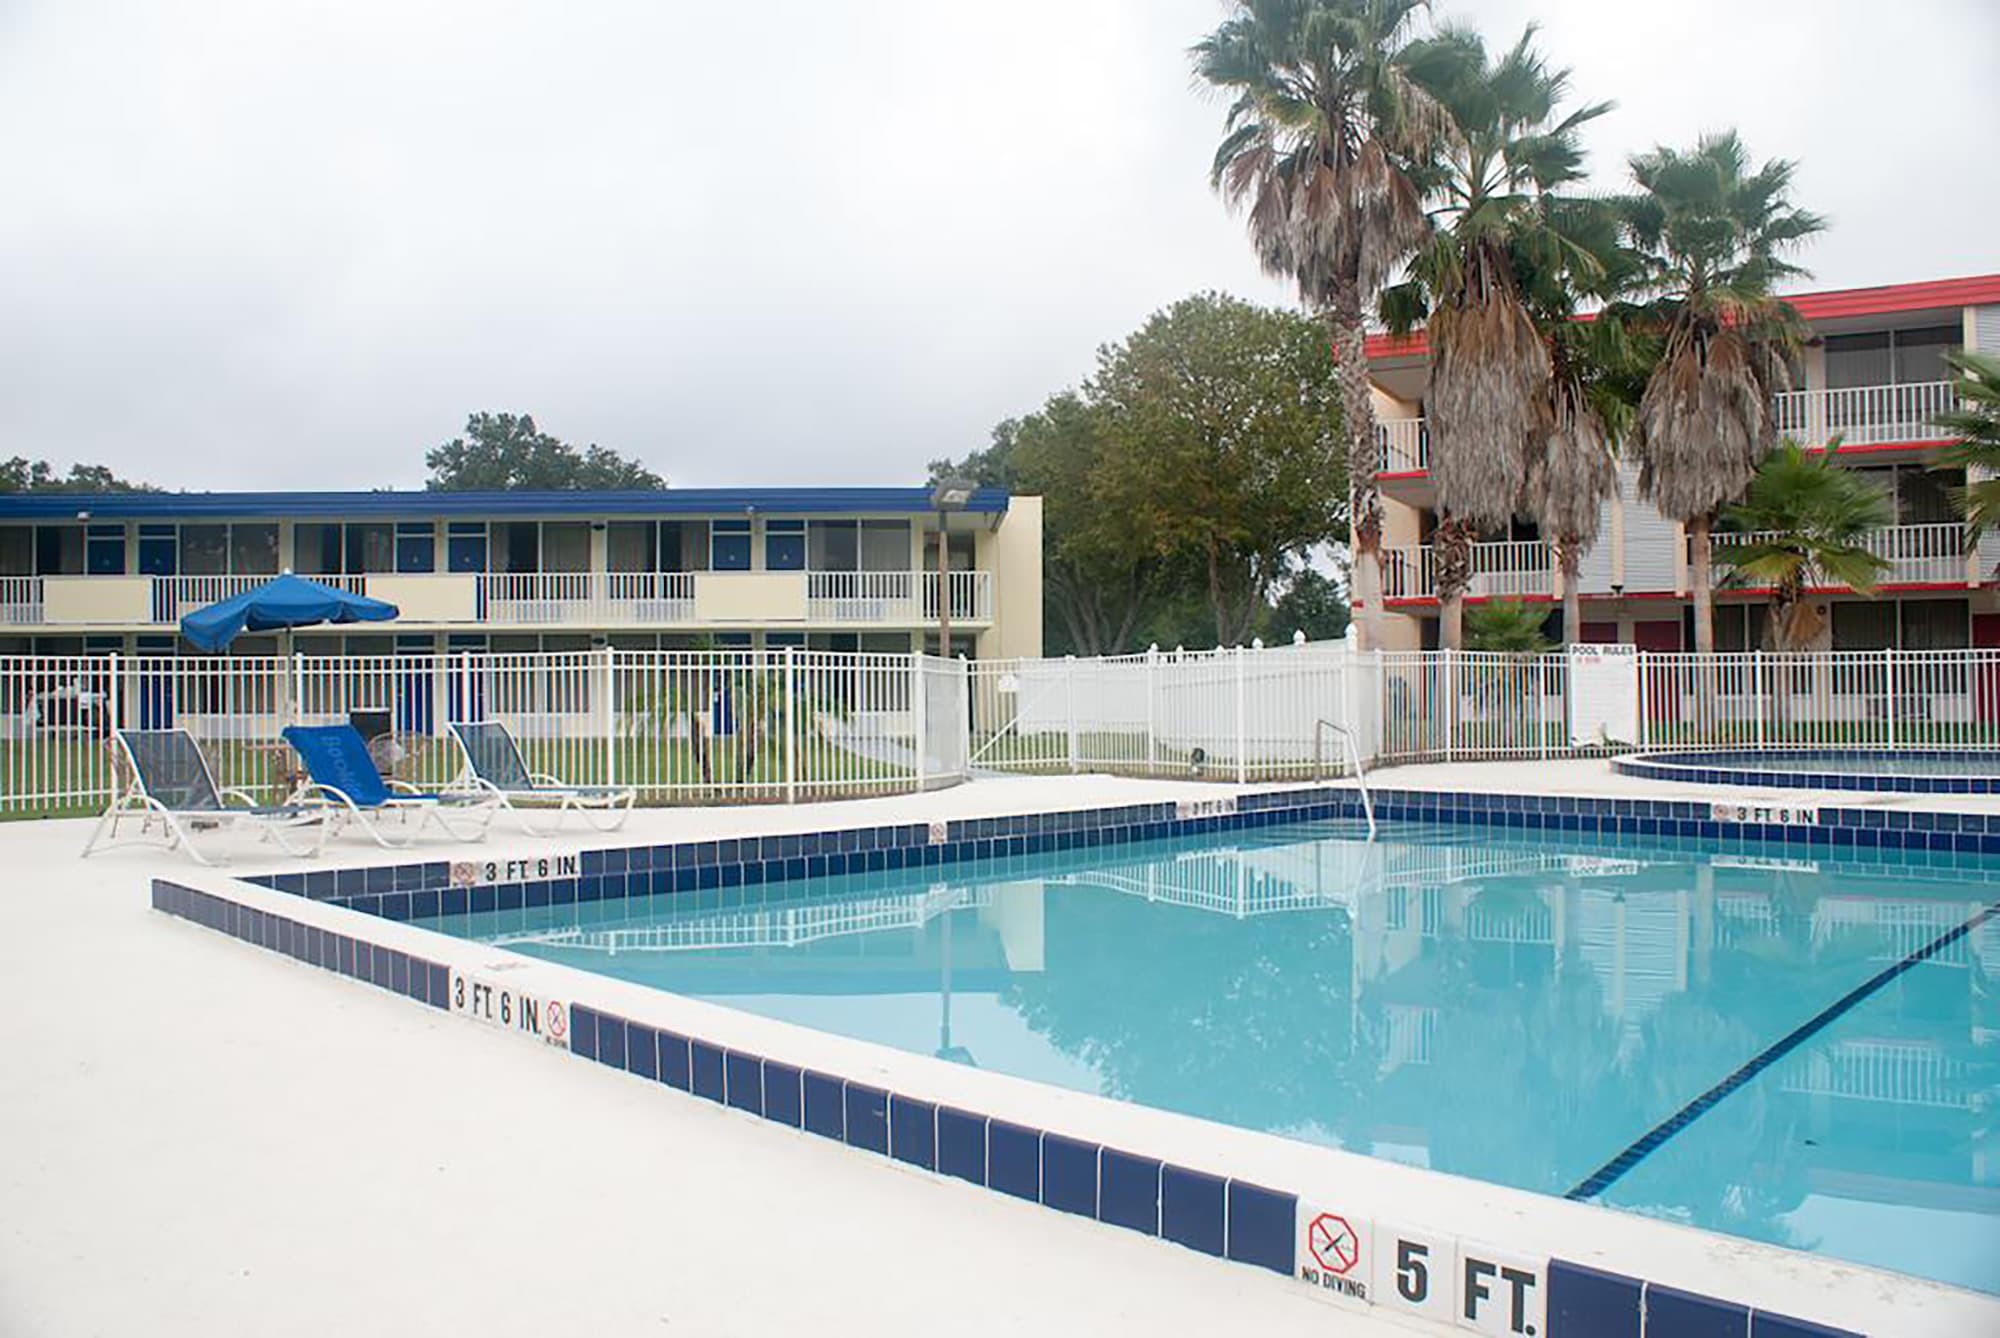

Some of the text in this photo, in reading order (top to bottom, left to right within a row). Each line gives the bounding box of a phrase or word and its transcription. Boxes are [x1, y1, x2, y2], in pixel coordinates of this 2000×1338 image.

[1571, 645, 1634, 656] POOL RULES
[1737, 806, 1747, 822] 3
[1780, 808, 1790, 823] 6
[485, 862, 497, 881] 3
[538, 858, 549, 877] 6
[455, 976, 465, 1008] 3
[501, 991, 511, 1024] 6
[520, 995, 542, 1035] IN.
[1302, 1266, 1367, 1300] NO DIVING
[1397, 1238, 1536, 1337] 5 FT.
